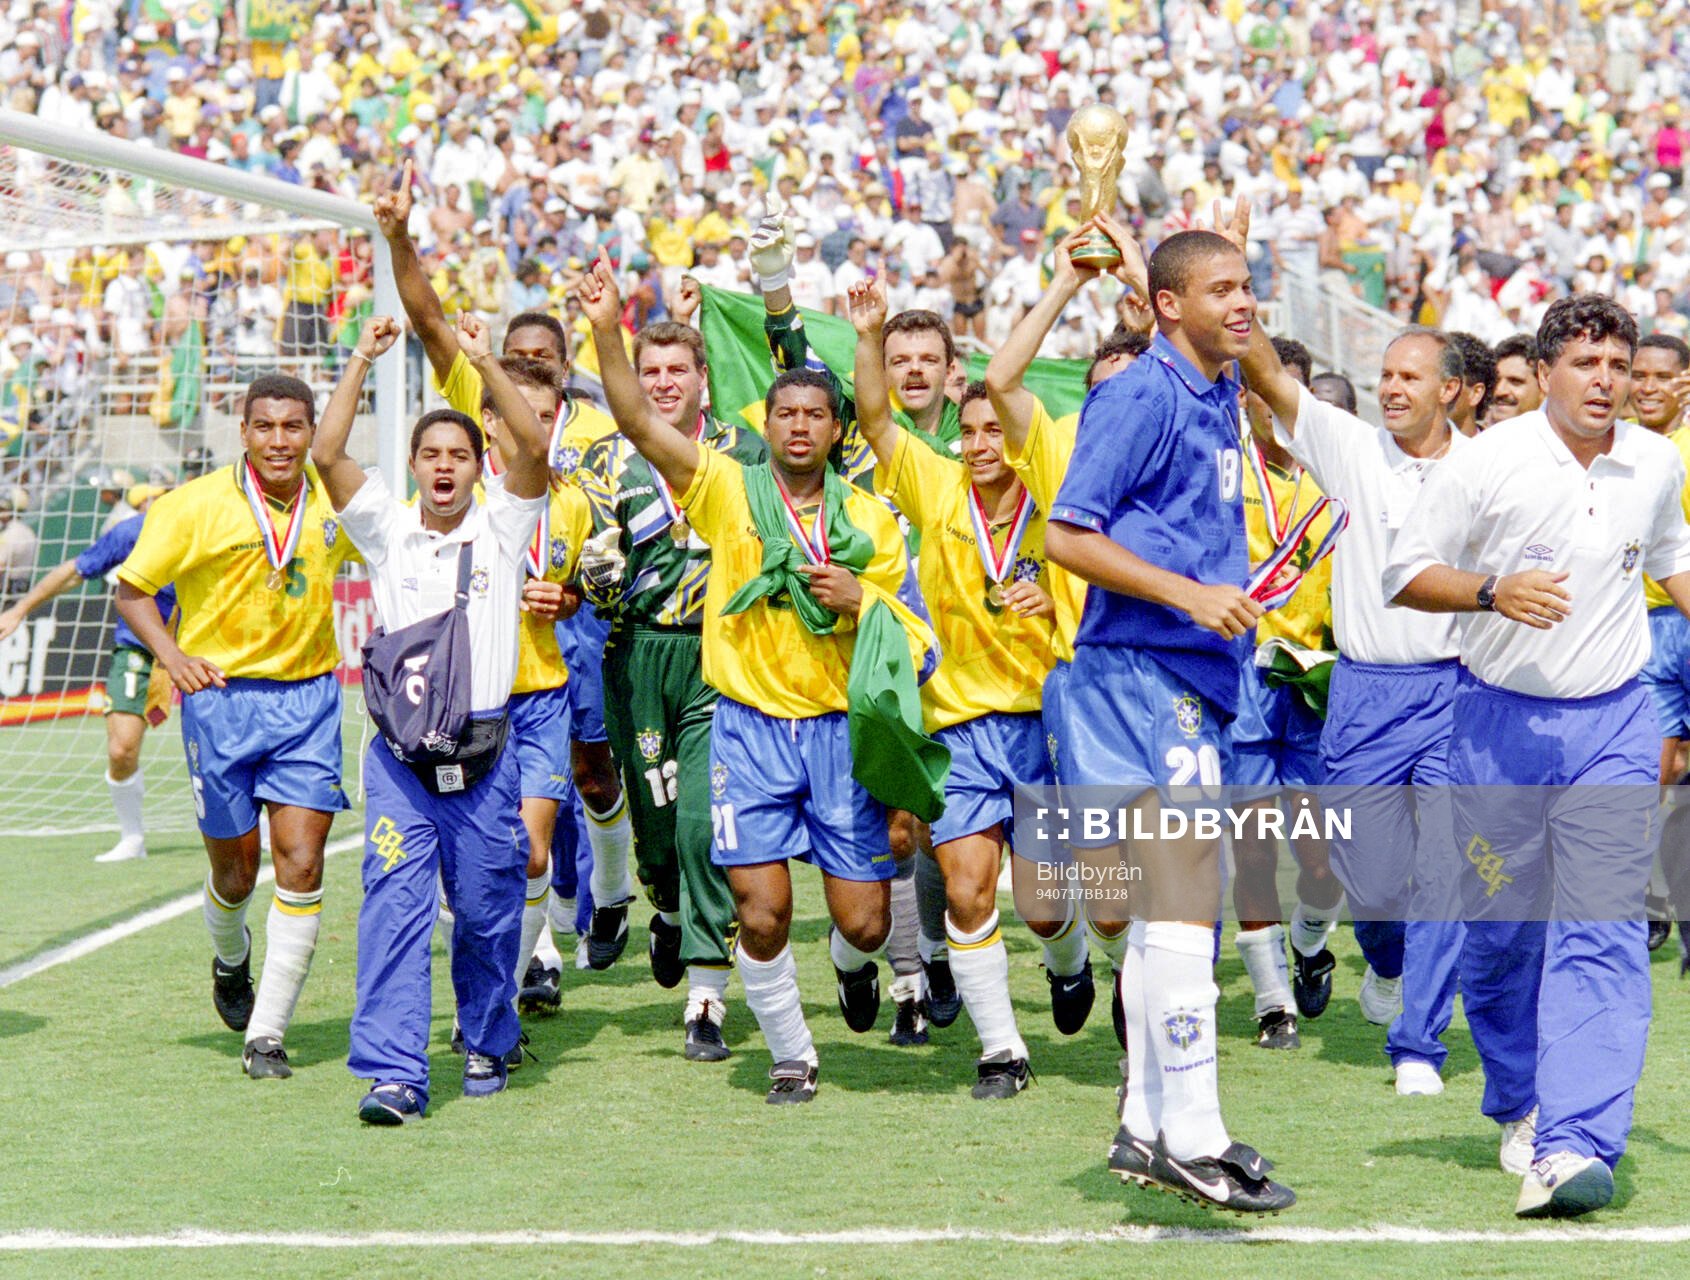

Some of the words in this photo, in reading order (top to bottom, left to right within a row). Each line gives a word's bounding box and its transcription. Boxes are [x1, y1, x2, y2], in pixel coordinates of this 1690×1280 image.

[230, 539, 267, 552] UMBR
[285, 556, 307, 599] 5
[124, 671, 137, 698] 1
[1165, 744, 1222, 803] 20
[369, 815, 408, 873] CBF
[1465, 832, 1514, 898] CBF
